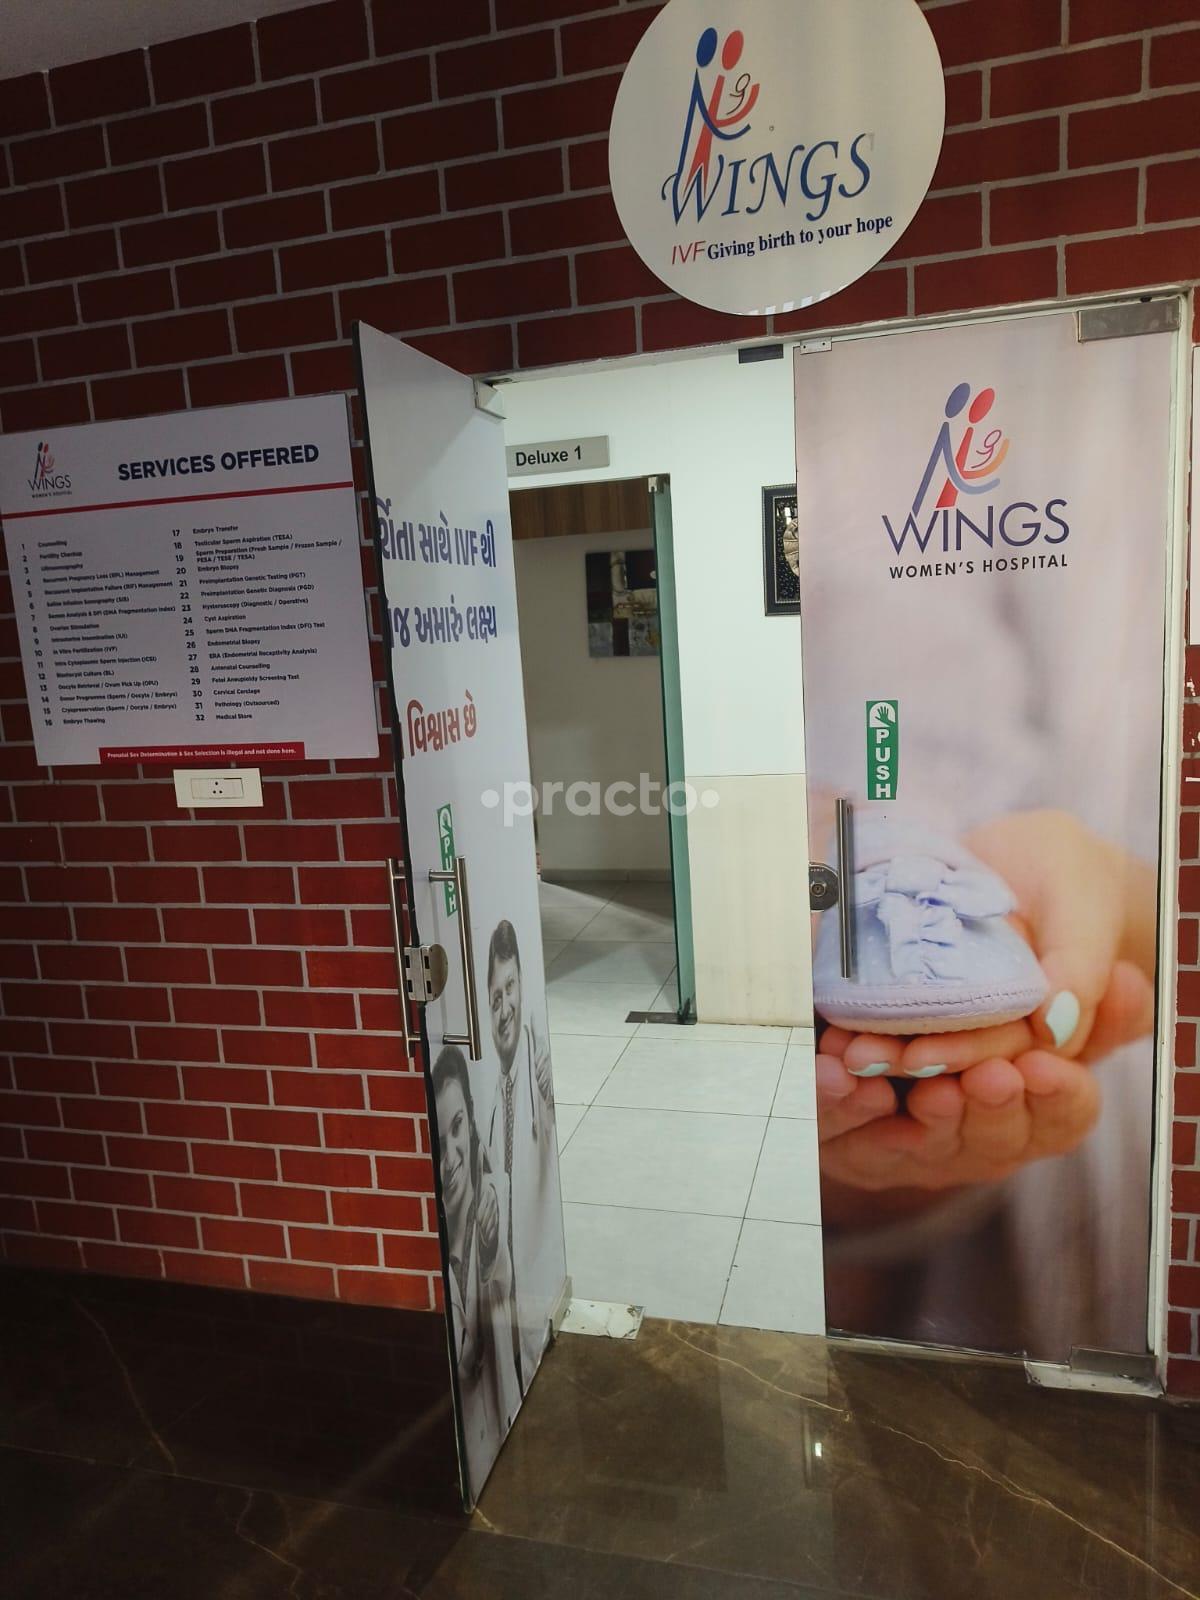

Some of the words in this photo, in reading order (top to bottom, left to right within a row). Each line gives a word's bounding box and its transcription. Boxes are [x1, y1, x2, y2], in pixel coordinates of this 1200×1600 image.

[661, 133, 871, 226] WINGS
[671, 240, 707, 265] IVF
[707, 240, 756, 261] Giving
[758, 230, 796, 253] birth
[799, 227, 815, 244] to
[817, 221, 854, 244] your
[856, 215, 895, 235] hope
[117, 452, 216, 482] SERVICES
[220, 443, 320, 471] OFFERED
[515, 450, 569, 467] Deluxe
[574, 445, 583, 461] 1
[27, 474, 72, 491] WINGS
[454, 527, 479, 566] IVF
[882, 498, 1070, 556] WINGS
[176, 554, 184, 562] 19
[889, 560, 975, 580] WOMEN'S
[983, 554, 1068, 573] HOSPITAL
[181, 604, 191, 612] 23
[875, 728, 892, 800] PUSH
[443, 837, 458, 914] PUSH
